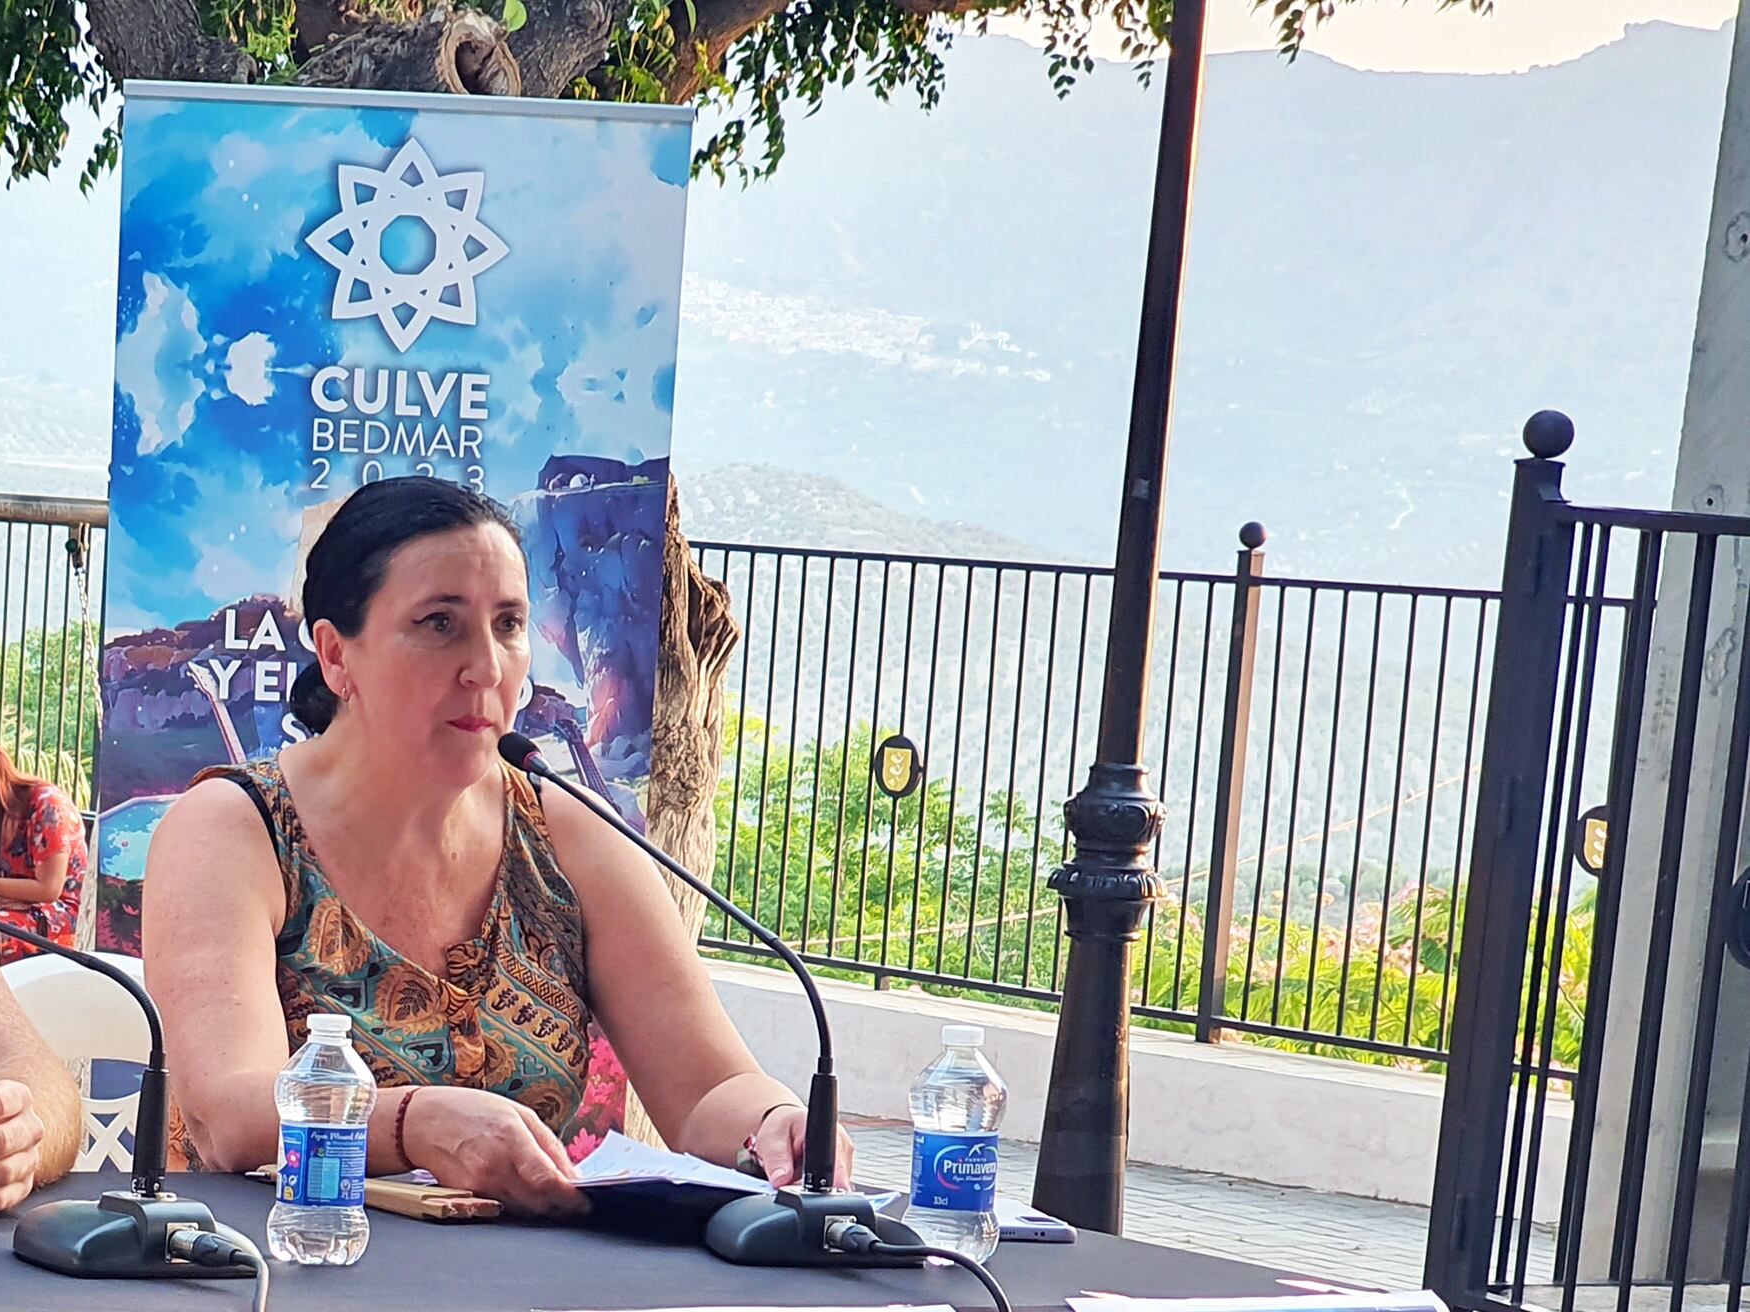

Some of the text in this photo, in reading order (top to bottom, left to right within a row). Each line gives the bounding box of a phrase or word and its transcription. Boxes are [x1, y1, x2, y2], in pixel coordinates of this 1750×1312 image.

[310, 365, 491, 420] CULVE
[312, 417, 483, 460] BEDMAR
[224, 608, 286, 651] LA
[208, 658, 242, 701] Y
